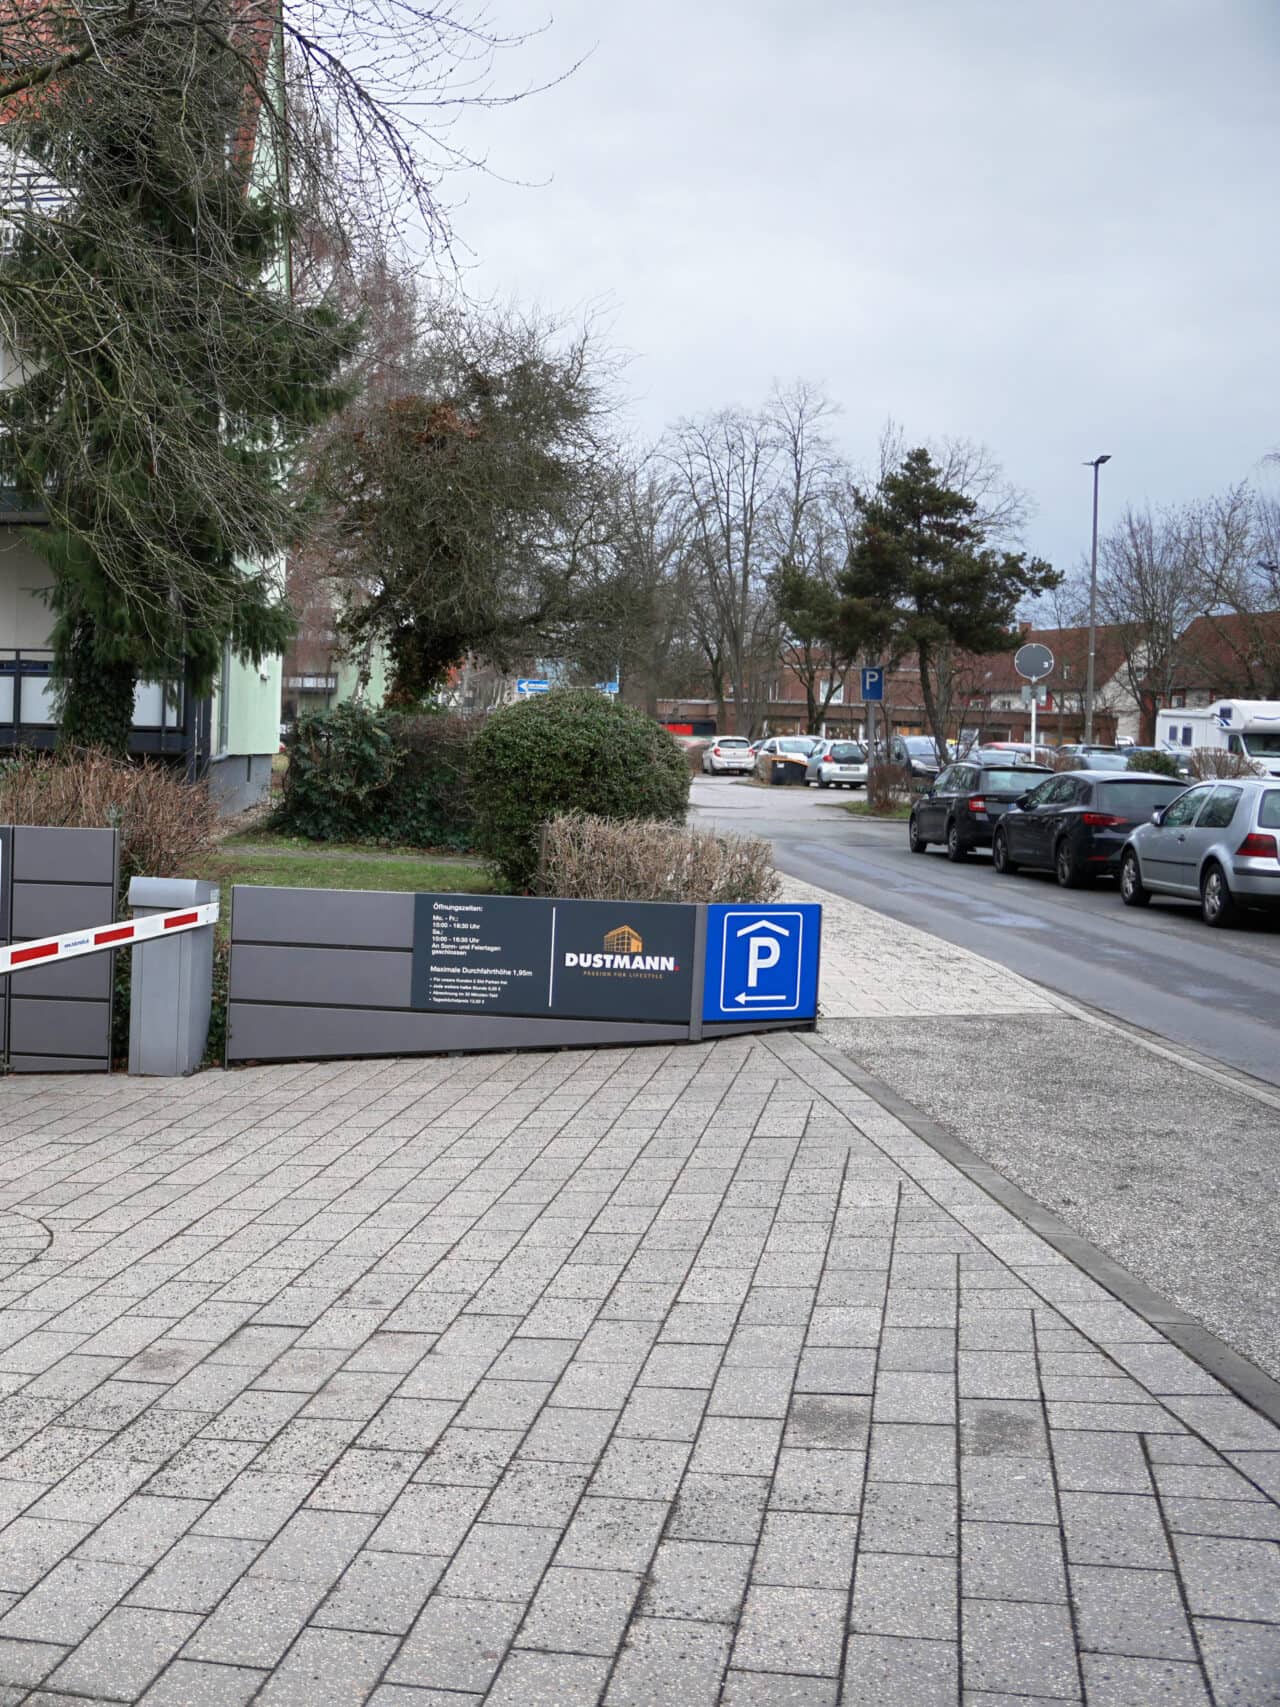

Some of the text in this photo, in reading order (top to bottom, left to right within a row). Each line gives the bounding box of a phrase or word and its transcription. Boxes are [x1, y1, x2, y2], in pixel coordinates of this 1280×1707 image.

[865, 671, 879, 690] P
[433, 902, 484, 912] Öffnungszeiten:
[430, 965, 461, 974] Maximale
[513, 969, 533, 977] 1,95m
[565, 953, 680, 972] DUSTMANN.
[747, 937, 780, 988] P
